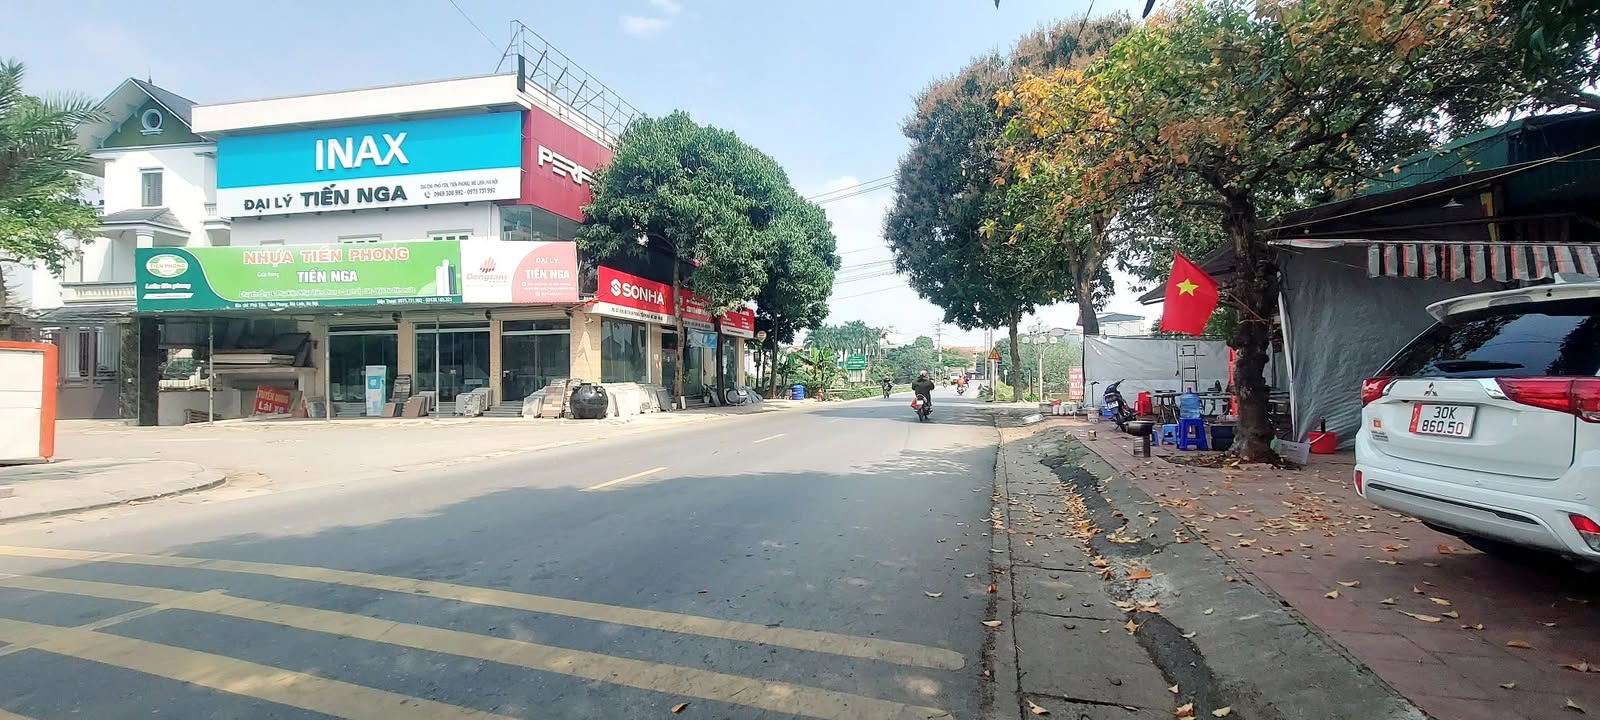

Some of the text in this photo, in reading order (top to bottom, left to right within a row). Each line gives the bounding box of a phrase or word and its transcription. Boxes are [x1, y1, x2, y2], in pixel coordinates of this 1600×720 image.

[315, 132, 409, 171] INAX
[538, 145, 595, 187] PERF
[244, 184, 407, 213] ĐẠI LÝ TIẾN NGA
[243, 246, 410, 268] NHỰA TIỀN PHONG
[535, 256, 560, 265] ĐẠI LÝ
[297, 267, 358, 283] TIẾN NGA
[525, 266, 570, 279] TIẾN NGA
[621, 282, 665, 305] SONHA
[1433, 406, 1458, 421] 30K
[1421, 421, 1464, 435] 860.50
